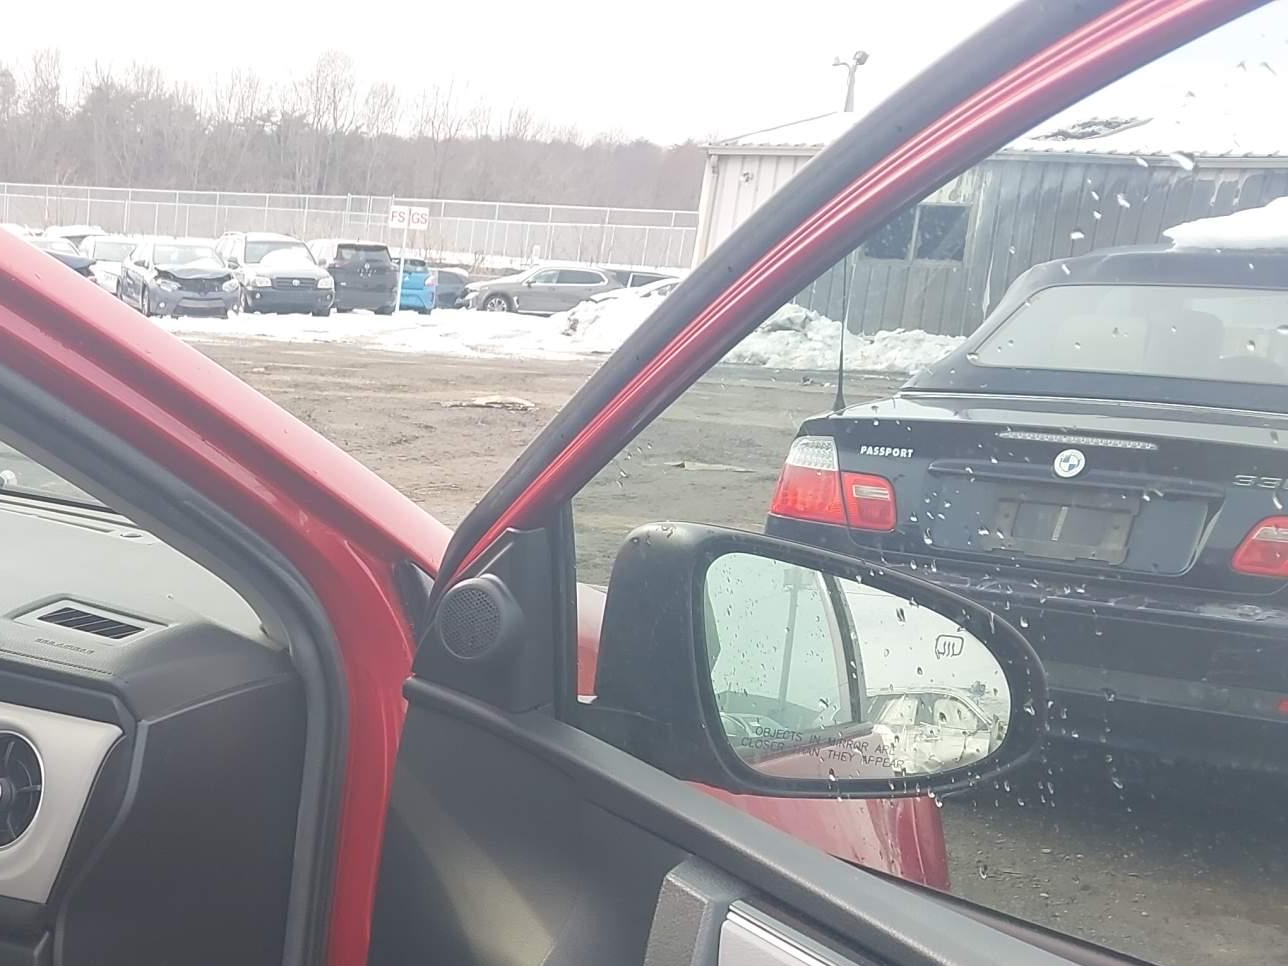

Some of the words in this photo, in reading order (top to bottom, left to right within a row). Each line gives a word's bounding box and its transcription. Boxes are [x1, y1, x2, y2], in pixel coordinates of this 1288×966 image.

[391, 211, 406, 223] FS
[411, 211, 428, 225] GS
[860, 446, 914, 458] PASSPORT
[1232, 474, 1288, 491] 33
[755, 726, 803, 742] OBJECTS
[809, 735, 821, 746] IN
[827, 737, 869, 751] MIRROR
[741, 737, 785, 751] CLOSER
[828, 750, 856, 763] THEY
[861, 755, 905, 769] APPEAR
